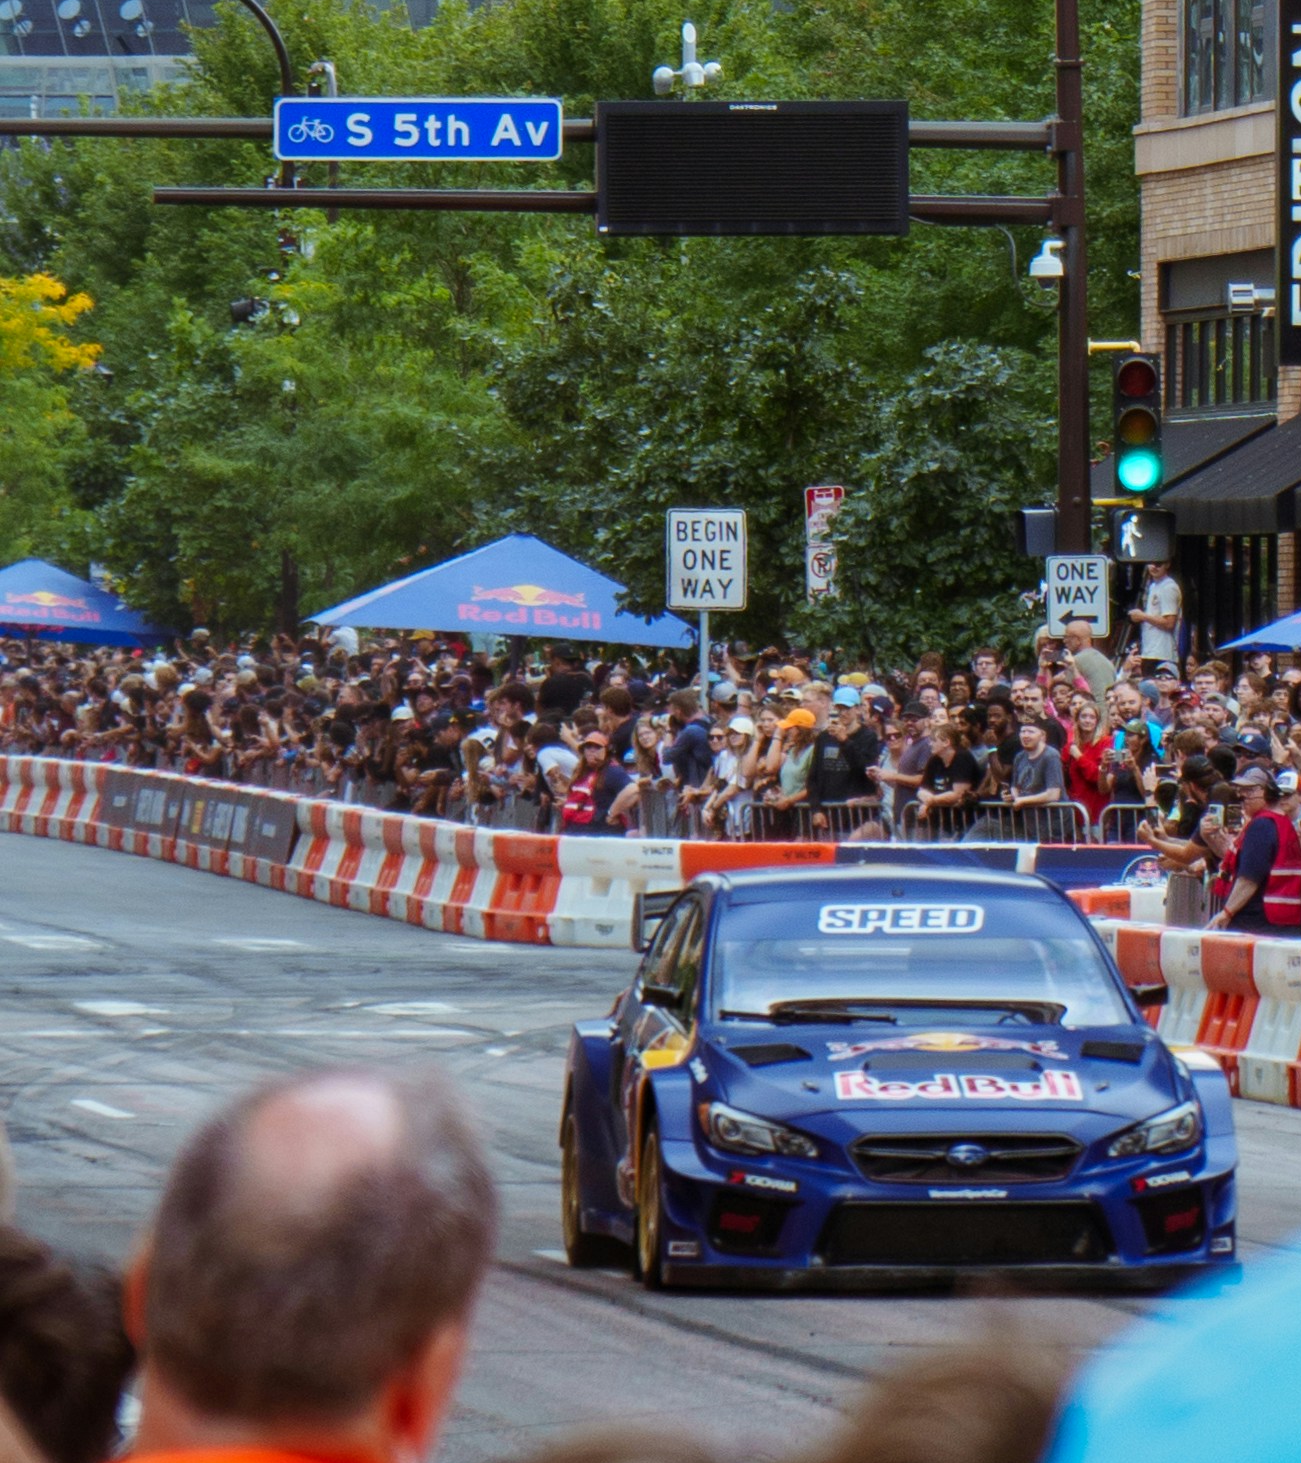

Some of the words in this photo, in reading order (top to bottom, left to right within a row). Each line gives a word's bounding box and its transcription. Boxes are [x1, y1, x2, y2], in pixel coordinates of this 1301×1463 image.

[346, 113, 373, 146] S
[393, 113, 470, 147] 5th
[490, 113, 549, 146] Av
[676, 520, 738, 542] BEGIN
[683, 549, 732, 571] ONE
[1056, 562, 1098, 581] ONE
[681, 578, 733, 600] WAY
[1055, 585, 1098, 604] WAY
[458, 603, 528, 624] Red
[533, 608, 602, 630] Bull
[819, 905, 983, 934] SPEED
[835, 1071, 961, 1100] Red
[961, 1069, 1084, 1101] Bull
